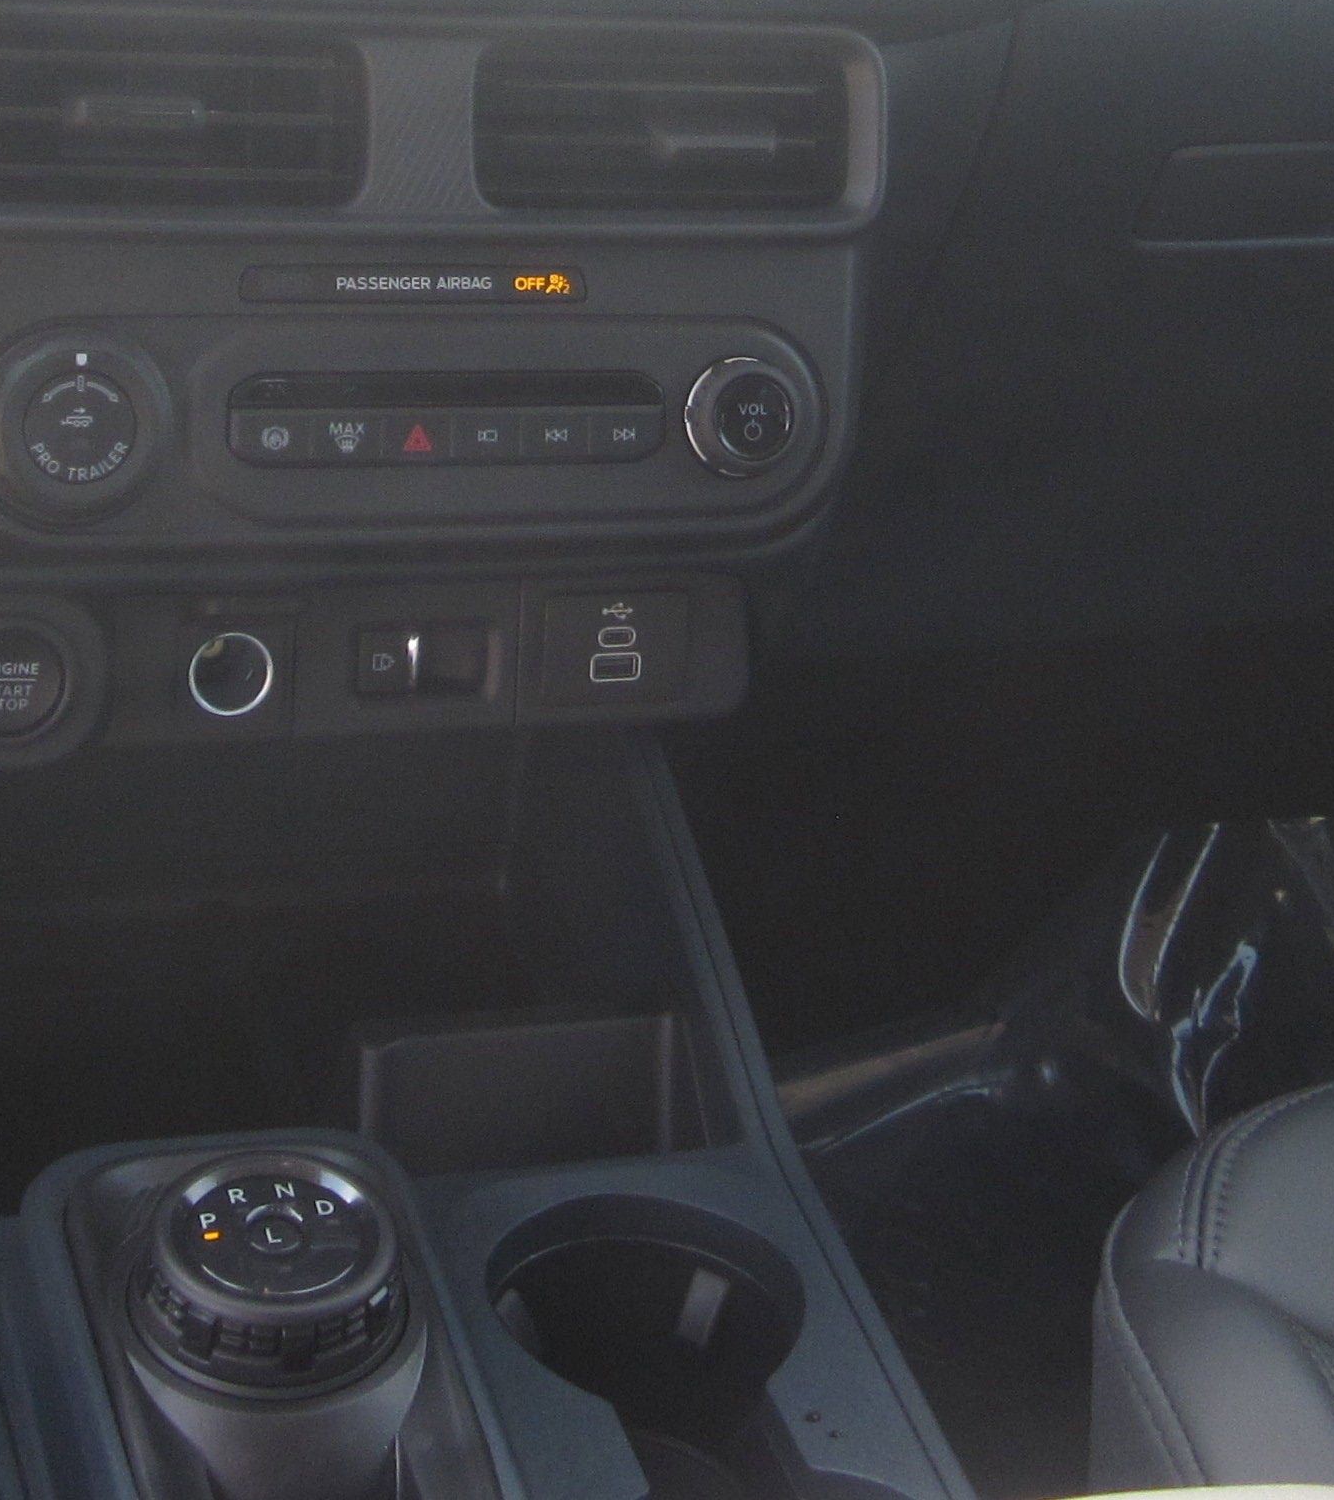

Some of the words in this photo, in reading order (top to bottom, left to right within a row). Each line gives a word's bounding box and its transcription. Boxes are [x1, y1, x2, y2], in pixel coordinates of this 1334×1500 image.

[336, 276, 431, 290] PASSENGER
[436, 276, 492, 290] AIRBAG
[514, 276, 545, 291] OFF
[738, 403, 767, 416] VOL
[329, 423, 365, 435] MAX
[30, 442, 60, 474] PRO
[67, 441, 128, 481] TRAILER
[227, 1187, 247, 1204] R
[274, 1182, 295, 1199] N
[315, 1199, 336, 1216] D
[198, 1212, 217, 1230] P
[265, 1227, 283, 1245] L
